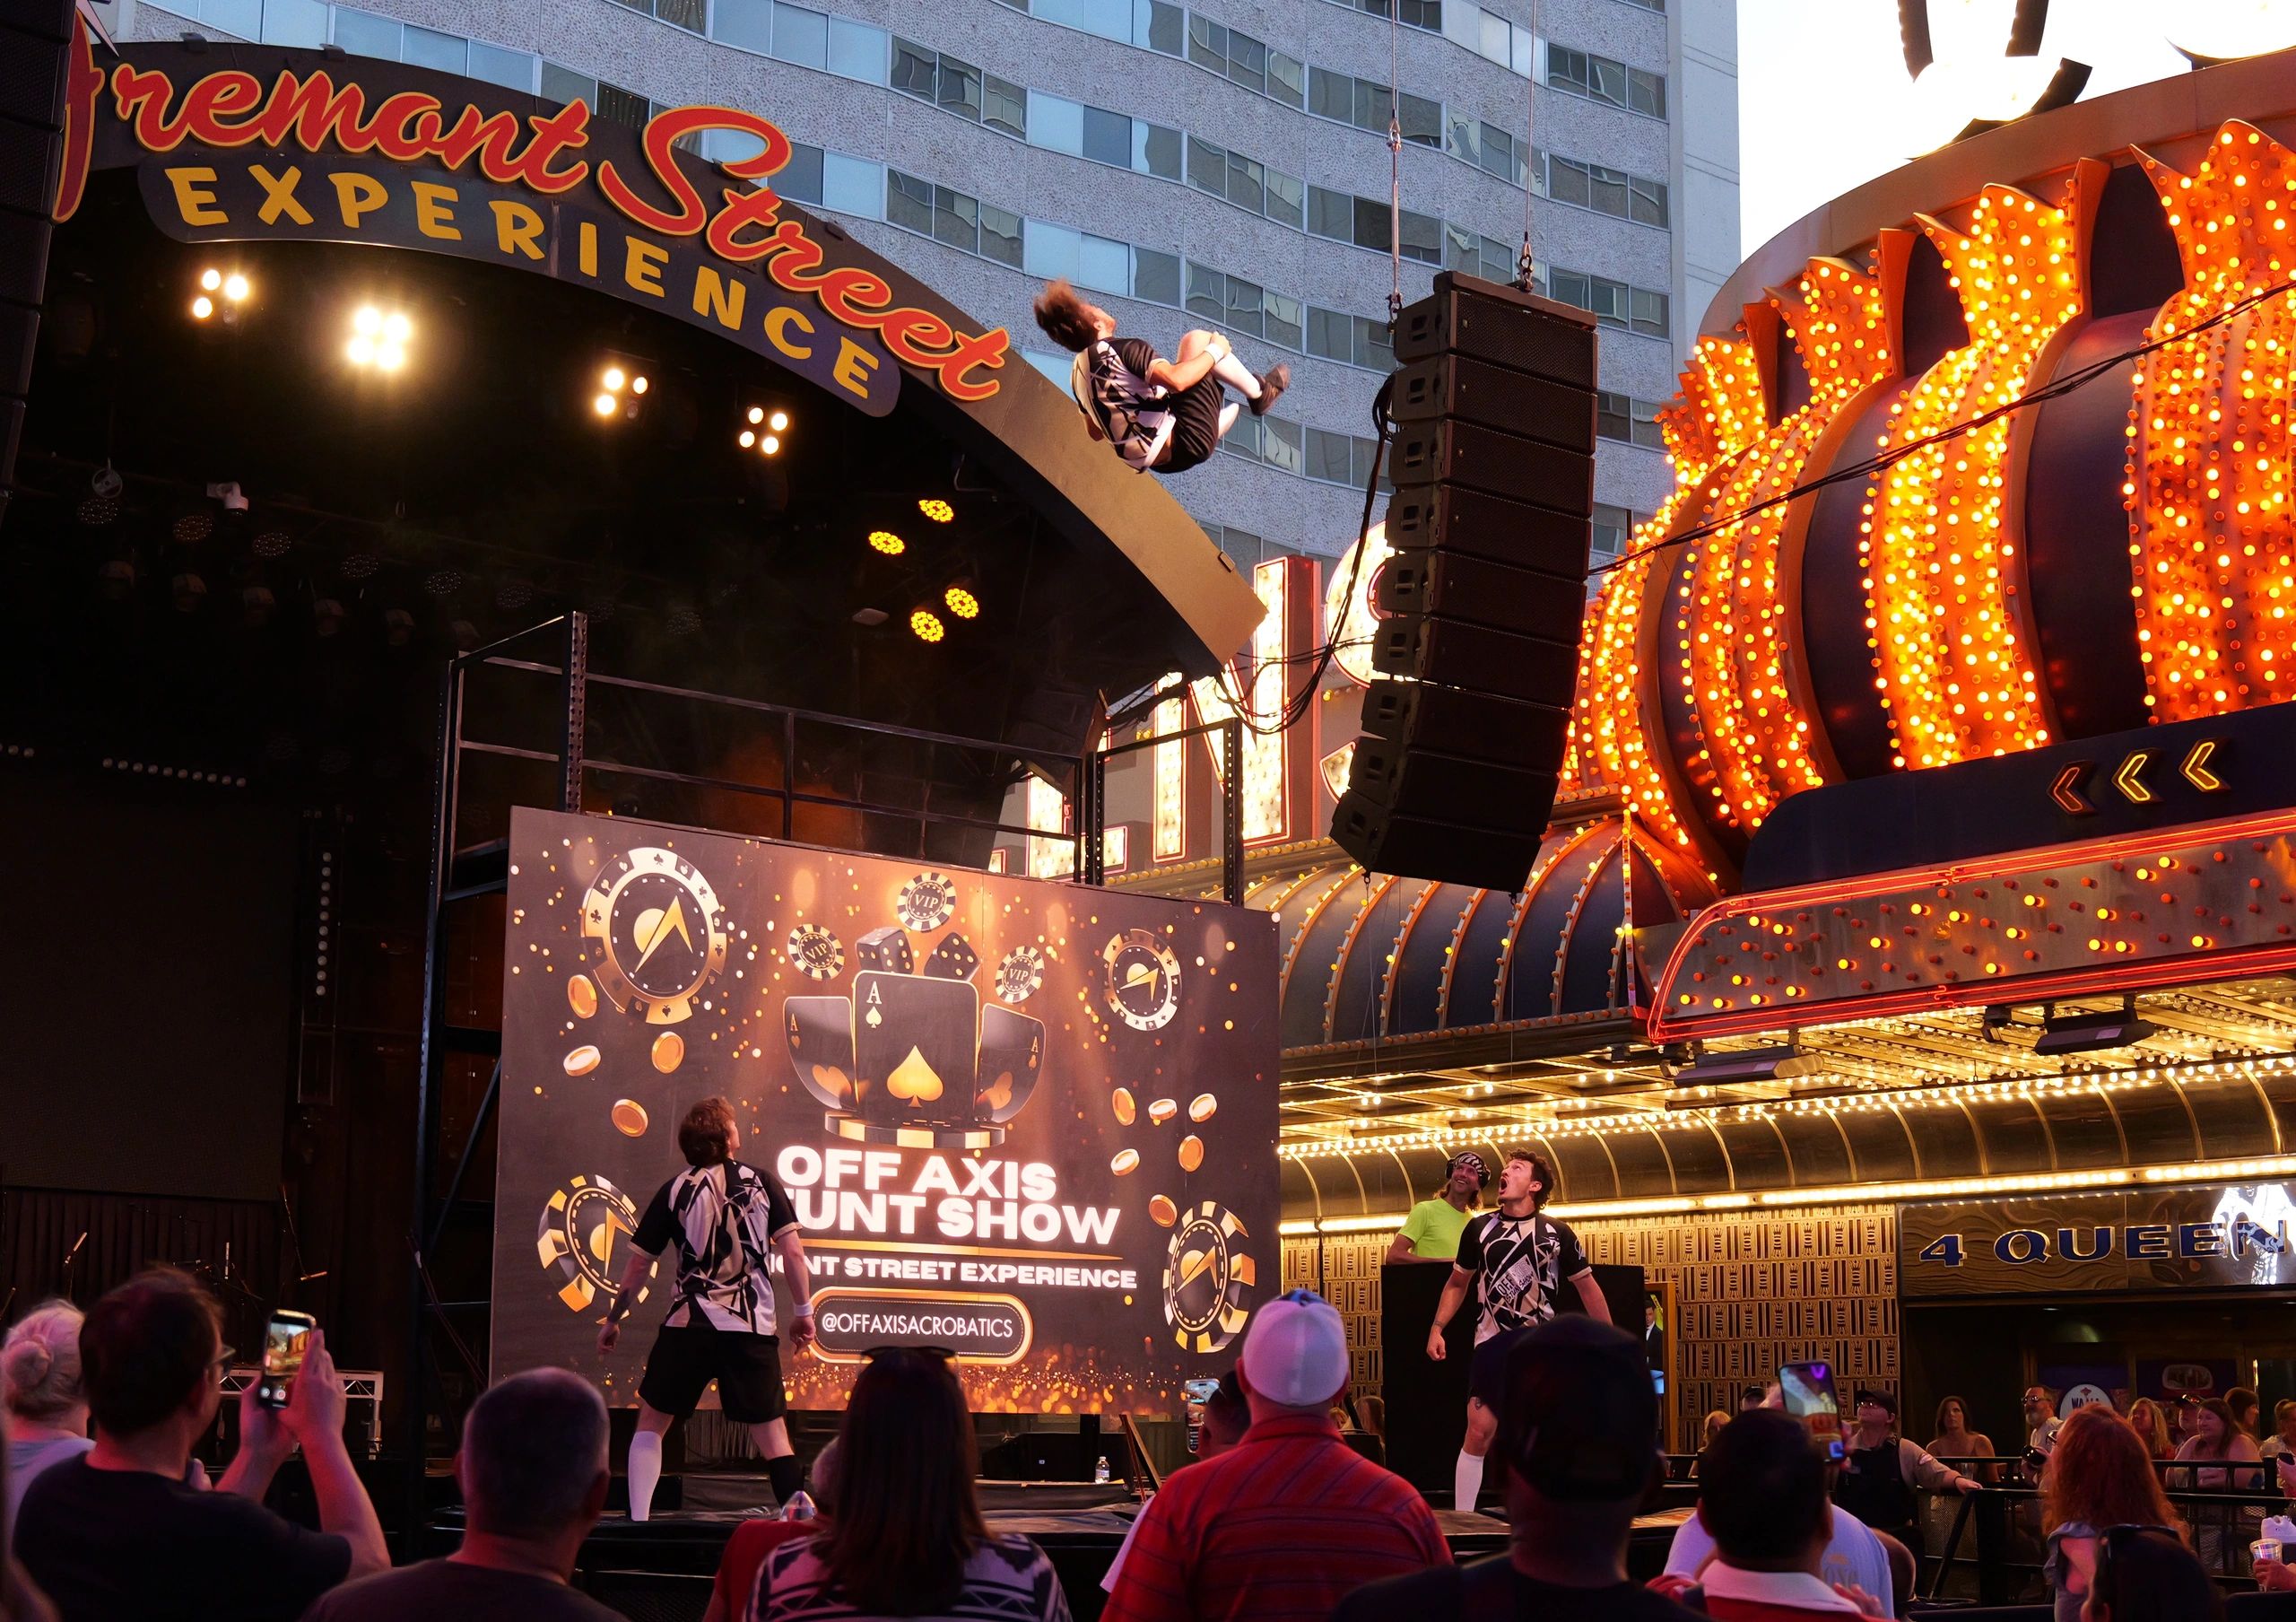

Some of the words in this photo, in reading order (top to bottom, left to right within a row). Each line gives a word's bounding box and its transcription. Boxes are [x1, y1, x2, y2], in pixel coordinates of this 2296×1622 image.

[597, 105, 1010, 401] Street
[165, 164, 880, 399] EXPERIENCE
[915, 894, 939, 910] VIP
[805, 942, 828, 961] VIP
[1009, 968, 1030, 981] VIP
[866, 980, 883, 1005] A
[790, 1013, 799, 1032] A
[1031, 1035, 1039, 1054] A
[777, 1145, 902, 1190] OFF
[911, 1155, 1057, 1202] AXIS
[783, 1187, 926, 1235] UNT
[936, 1199, 1121, 1245] SHOW
[1918, 1233, 1968, 1269] 4
[844, 1257, 957, 1282] STREET
[961, 1262, 1137, 1290] EXPERIENCE
[822, 1312, 1014, 1339] @OFFAXISACROBATICS
